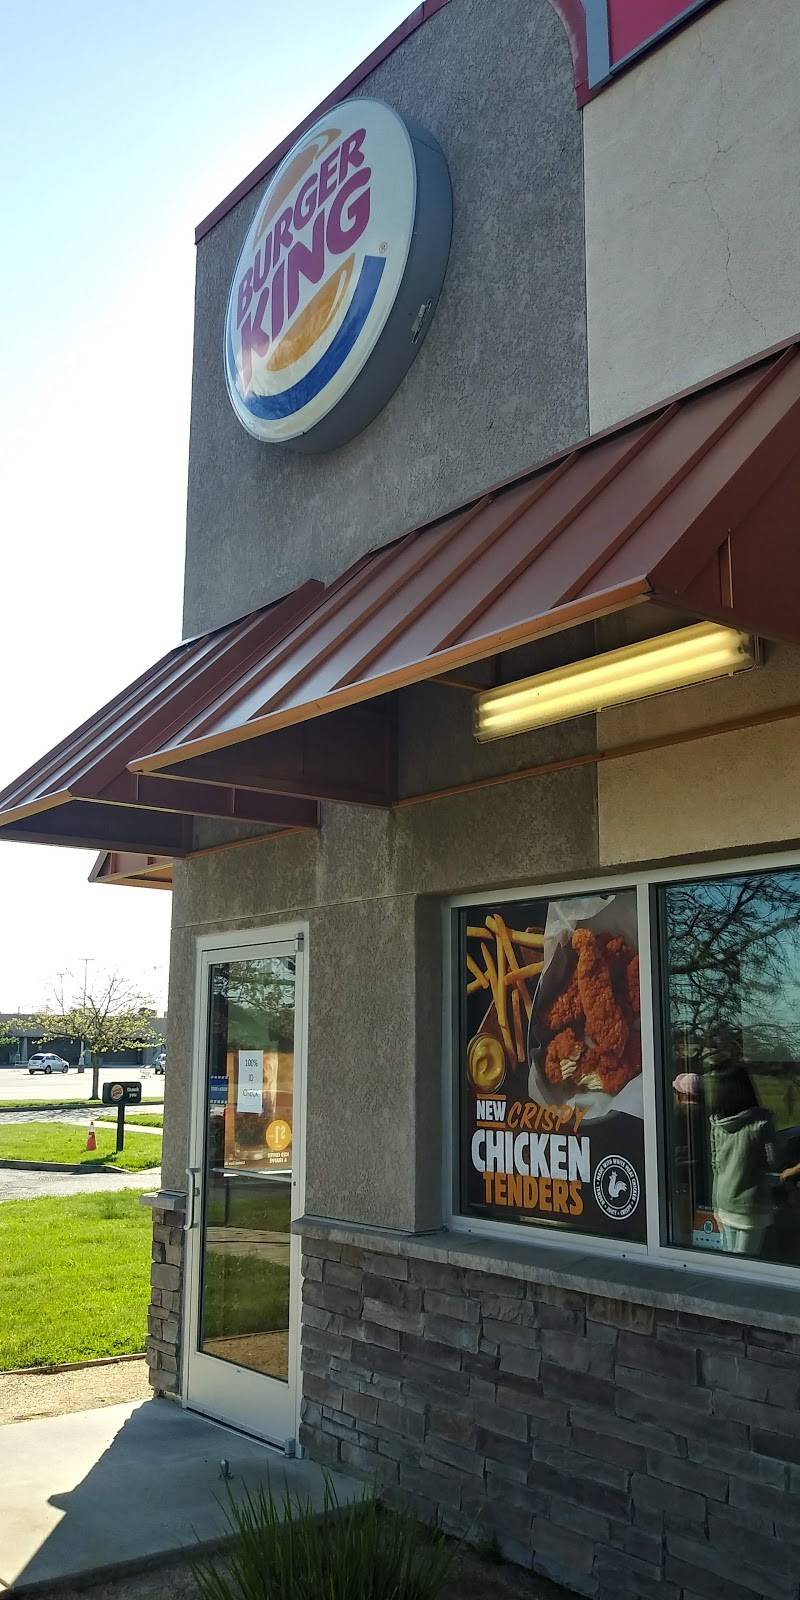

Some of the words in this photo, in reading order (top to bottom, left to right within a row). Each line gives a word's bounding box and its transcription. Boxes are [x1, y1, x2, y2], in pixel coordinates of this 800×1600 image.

[236, 127, 367, 330] BURGER
[240, 166, 372, 393] KING
[245, 1058, 258, 1067] 100%
[248, 1073, 254, 1081] ID
[476, 1099, 507, 1122] NEW
[507, 1101, 590, 1133] CRISPY
[471, 1128, 591, 1183] CHICKEN
[482, 1172, 585, 1217] TENDERS
